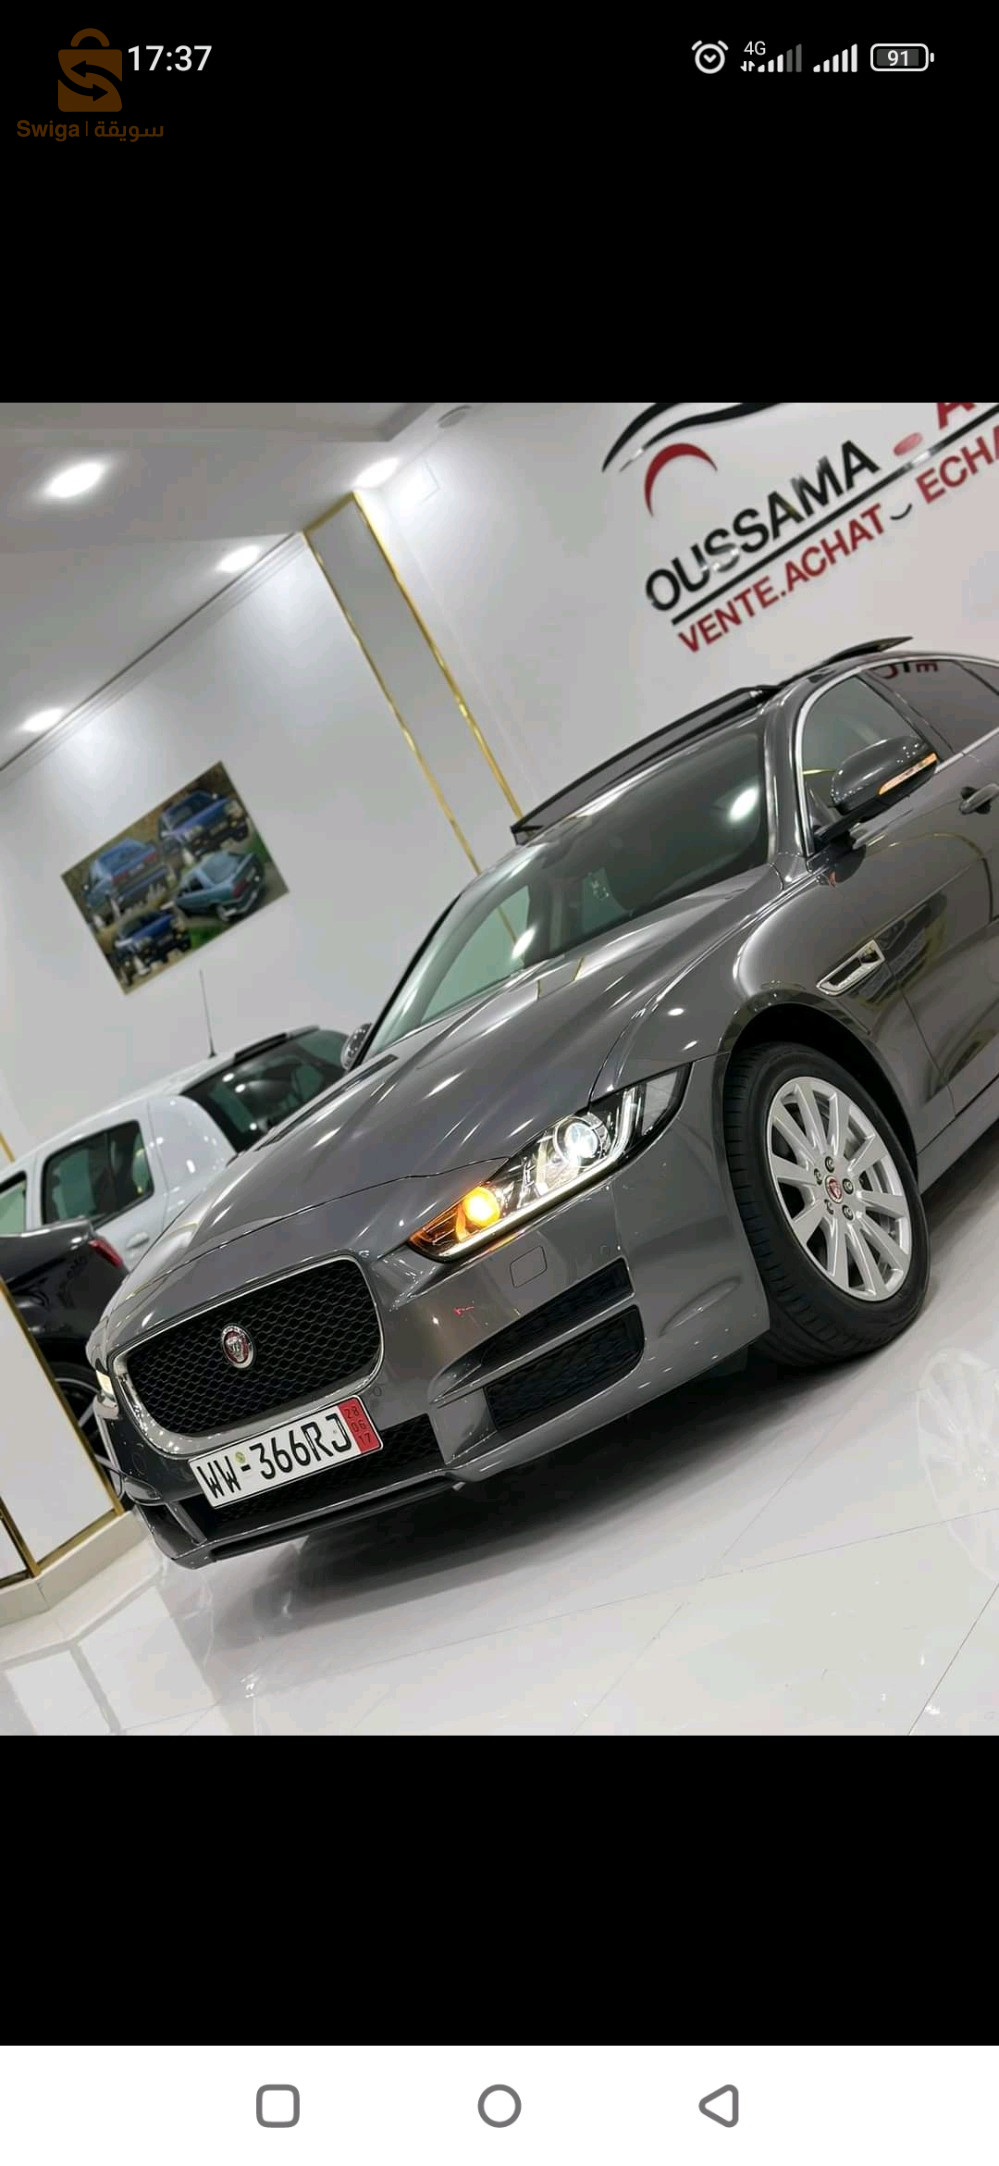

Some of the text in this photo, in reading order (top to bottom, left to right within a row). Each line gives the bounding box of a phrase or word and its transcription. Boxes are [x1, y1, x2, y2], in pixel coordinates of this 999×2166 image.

[645, 440, 880, 612] OUSSAMA
[344, 1405, 359, 1418] 28
[352, 1419, 366, 1432] 06
[358, 1433, 372, 1446] 17
